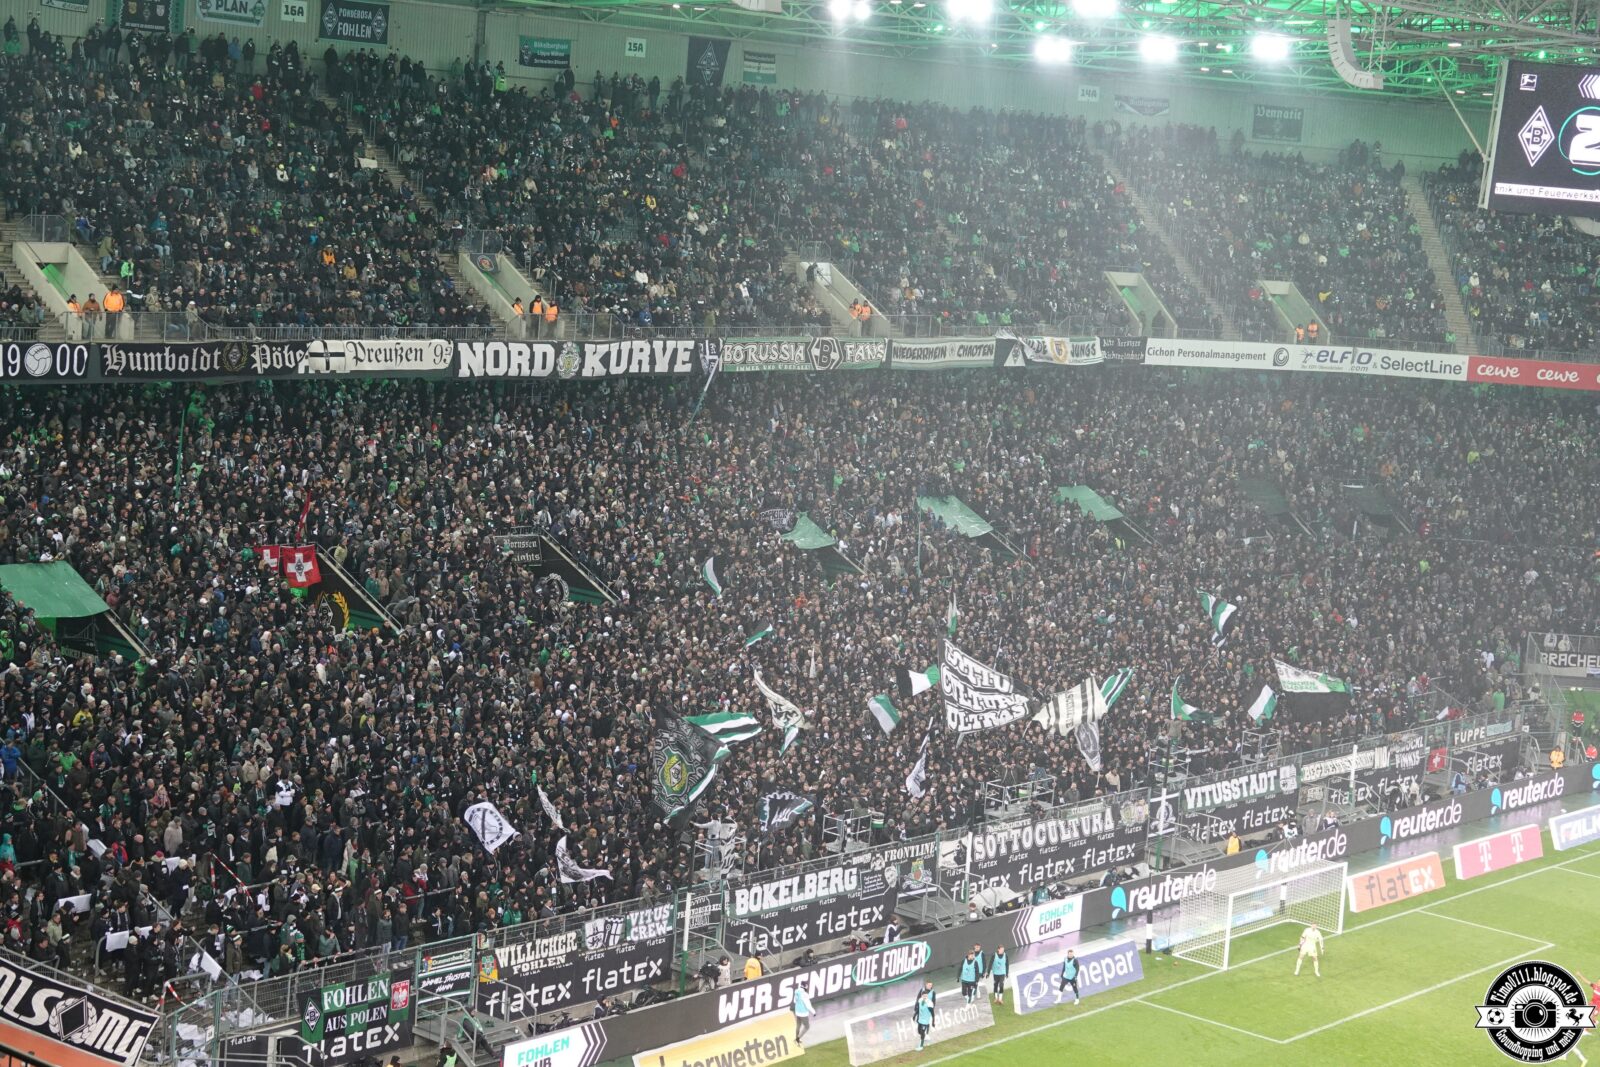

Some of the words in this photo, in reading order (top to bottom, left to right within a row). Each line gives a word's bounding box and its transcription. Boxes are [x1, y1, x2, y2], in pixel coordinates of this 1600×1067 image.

[215, 0, 248, 14] PLAN
[283, 6, 305, 17] 16A
[338, 7, 373, 20] PONDEROSA
[337, 22, 373, 39] FOHLEN
[627, 41, 644, 53] 15A
[1079, 88, 1097, 99] 14A
[1516, 186, 1535, 196] und
[101, 343, 221, 376] Humboldt
[250, 342, 311, 374] Pöbe
[346, 341, 424, 368] Preußen
[458, 341, 556, 378] NORD
[581, 340, 695, 377] KURVE
[721, 341, 806, 364] BORUSSIA
[843, 341, 885, 363] FANS
[892, 343, 947, 360] NIEDERRHEIN
[956, 342, 994, 360] CHAOTEN
[1071, 342, 1097, 358] JUNGS
[1147, 346, 1175, 358] Cichon
[1177, 348, 1266, 361] Personalmanagement
[1380, 355, 1463, 376] SelectLine
[1476, 363, 1521, 378] cewe
[1536, 367, 1580, 383] cewe
[946, 700, 1028, 732] ULTRAS
[1454, 726, 1485, 745] FUPPE
[1184, 769, 1278, 810] VITUSSTADT
[1502, 771, 1565, 810] reuter.de
[1392, 798, 1462, 840] reuter.de
[974, 805, 1115, 862] SOTTOCULTURA
[884, 841, 937, 862] FRONTLINE
[1269, 829, 1347, 873] reuter.de
[735, 866, 858, 916] BÖKELBERG
[1128, 863, 1217, 912] reuter.de
[629, 903, 671, 927] VITUS
[1038, 901, 1074, 923] FOHLEN
[630, 919, 669, 942] CREW
[1038, 920, 1063, 937] CLUB
[494, 929, 578, 968] WILLICHER
[512, 954, 567, 976] FOHLEN
[856, 953, 879, 986] DIE
[882, 940, 927, 979] FOHLEN
[322, 977, 390, 1012] FOHLEN
[718, 985, 773, 1024] WIR
[325, 1013, 348, 1033] AUS
[349, 1004, 388, 1028] POLEN
[84, 1008, 151, 1067] MG
[517, 1036, 570, 1066] FOHLEN
